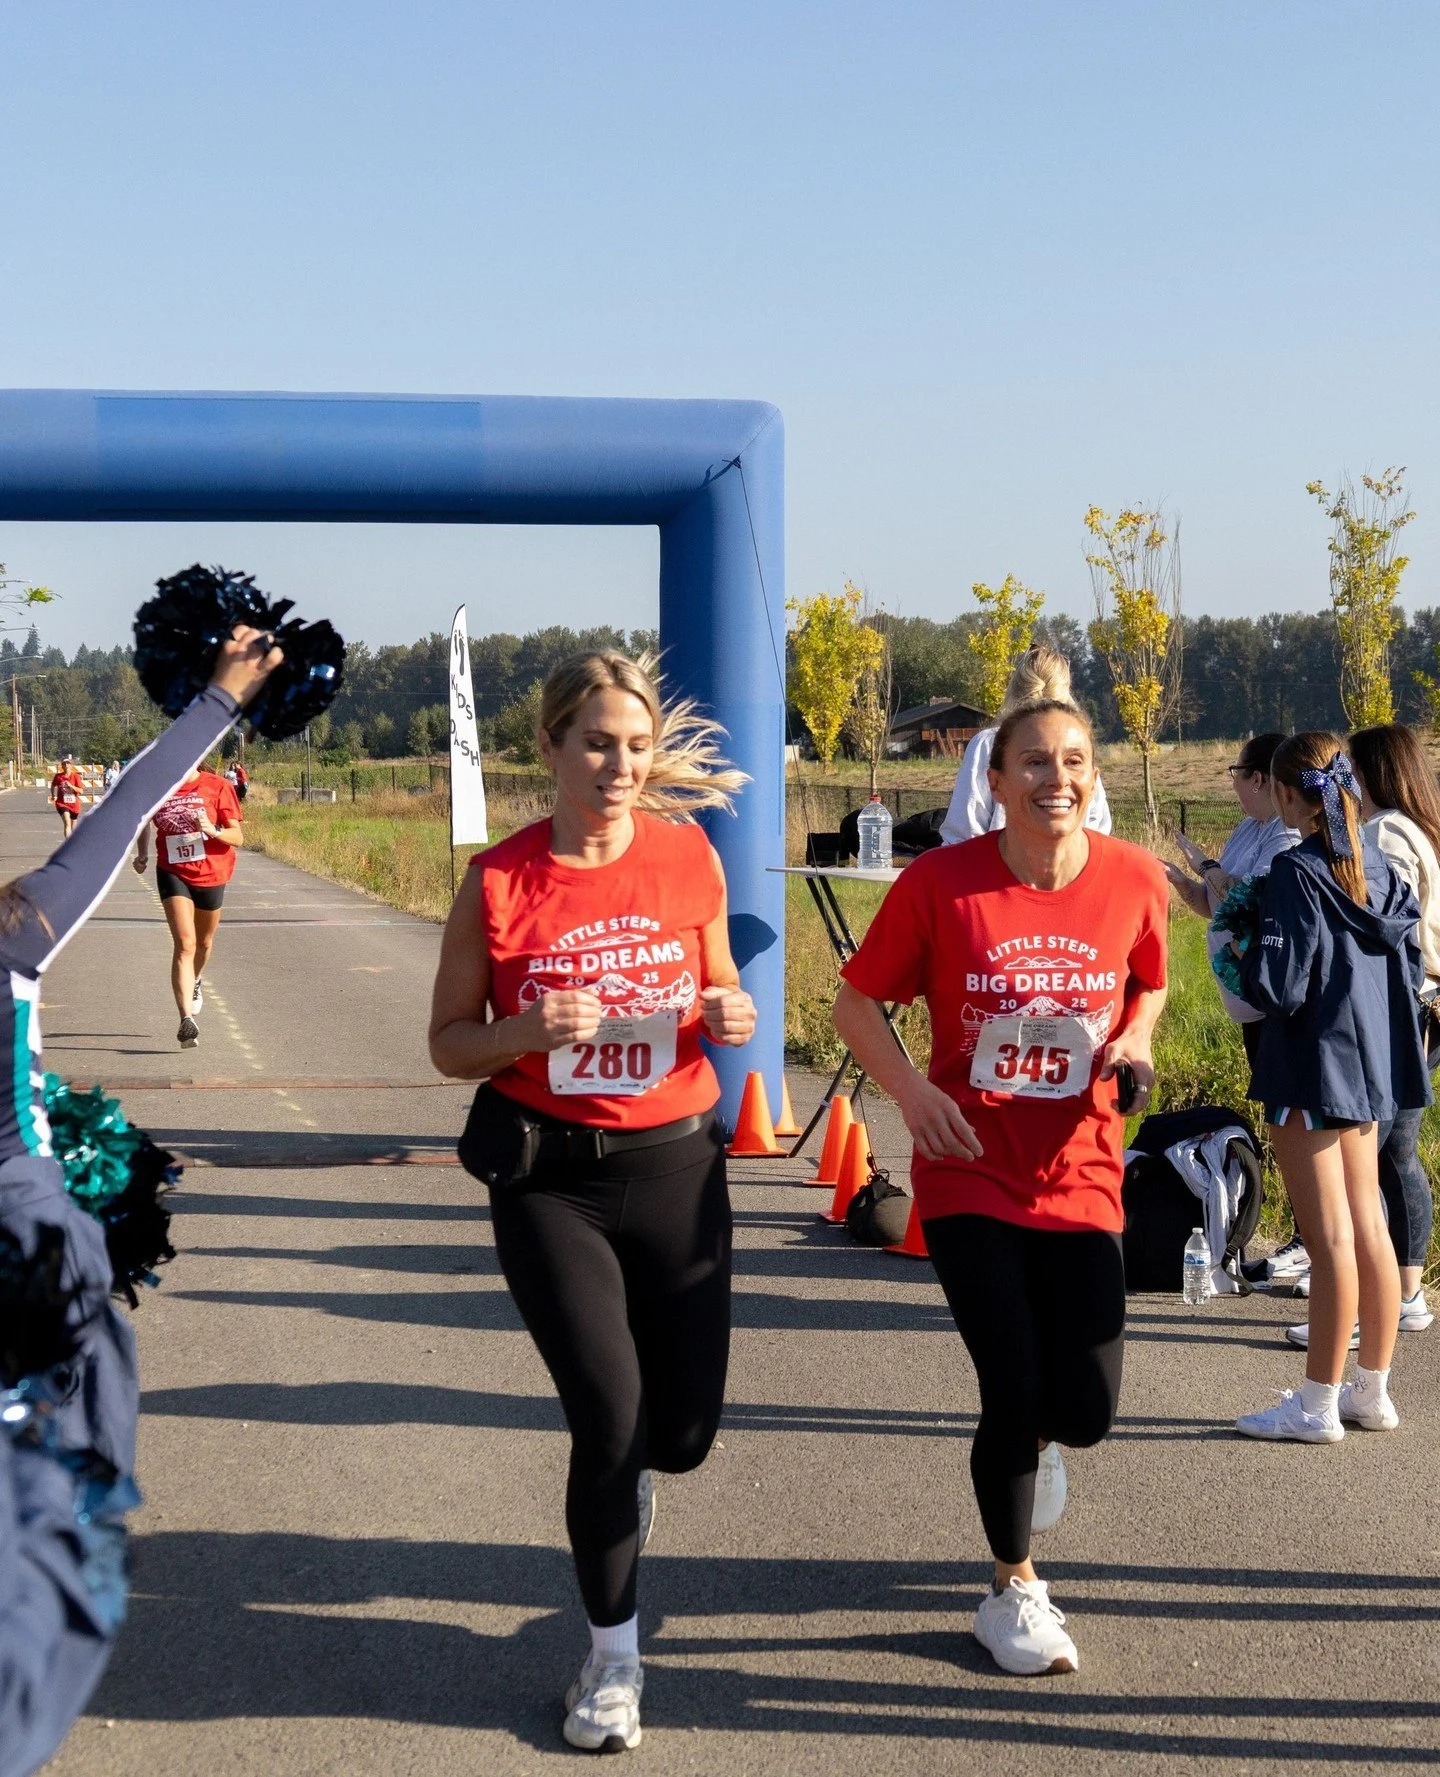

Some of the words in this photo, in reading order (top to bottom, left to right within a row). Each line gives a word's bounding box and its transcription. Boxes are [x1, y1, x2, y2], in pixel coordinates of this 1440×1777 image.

[451, 674, 473, 720] KIDS
[450, 719, 480, 766] DASH
[176, 844, 195, 858] 157
[549, 920, 606, 951] LITTLE
[609, 915, 661, 932] STEPS
[986, 935, 1043, 962] LITTLE
[1047, 935, 1099, 961] STEPS
[528, 955, 574, 973] BIG
[580, 940, 685, 973] DREAMS
[565, 976, 585, 986] 20
[641, 971, 659, 985] 25
[966, 973, 1008, 993] BIG
[1014, 971, 1117, 993] DREAMS
[1000, 999, 1018, 1010] 20
[1071, 998, 1088, 1008] 25
[571, 1042, 652, 1080] 280
[994, 1043, 1070, 1085] 345
